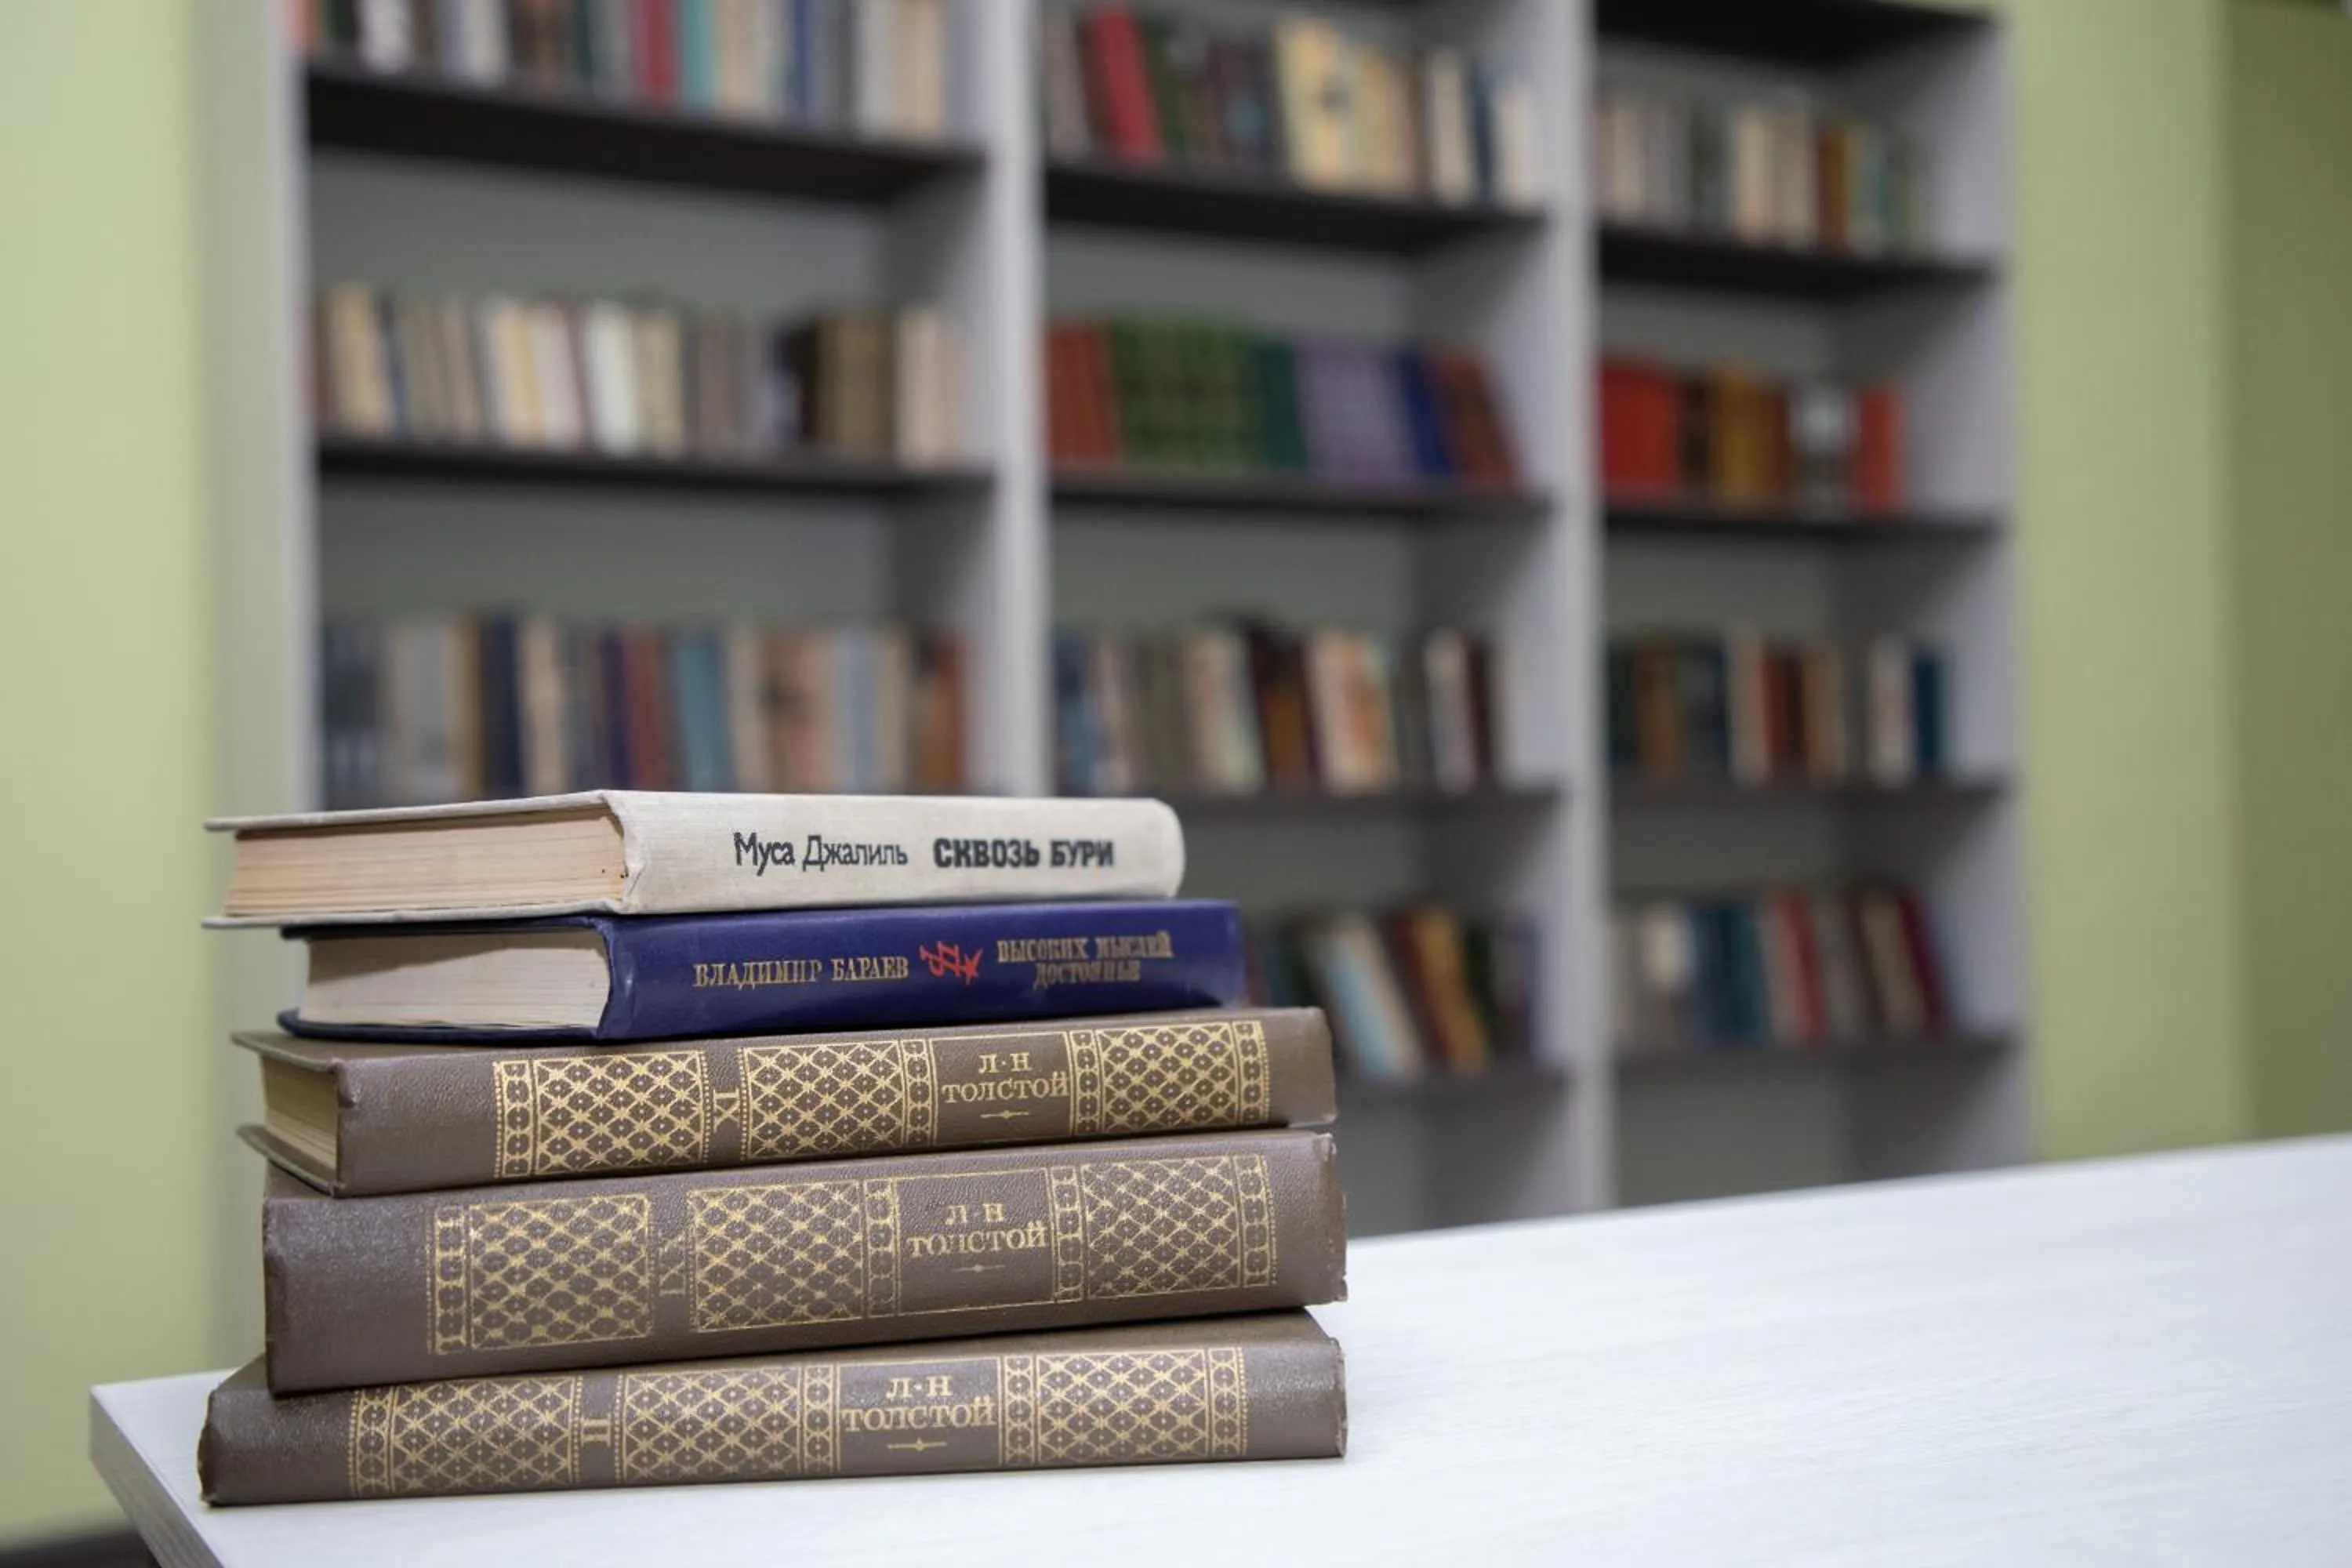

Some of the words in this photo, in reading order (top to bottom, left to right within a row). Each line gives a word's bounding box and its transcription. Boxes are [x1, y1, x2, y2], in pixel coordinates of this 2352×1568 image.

[734, 832, 795, 876] Муса
[802, 835, 908, 871] Джалиль
[933, 837, 1040, 868] СКВОЗЬ
[1049, 840, 1115, 868] БУРИ
[692, 960, 822, 991] ВЛАДИМИР
[830, 956, 909, 981] БАРАЕВ
[942, 1071, 1071, 1105] ТОЛСТОЙ
[906, 1220, 1048, 1258] ТОЛСТОЙ
[841, 1396, 997, 1432] ТОЛСТОЙ
